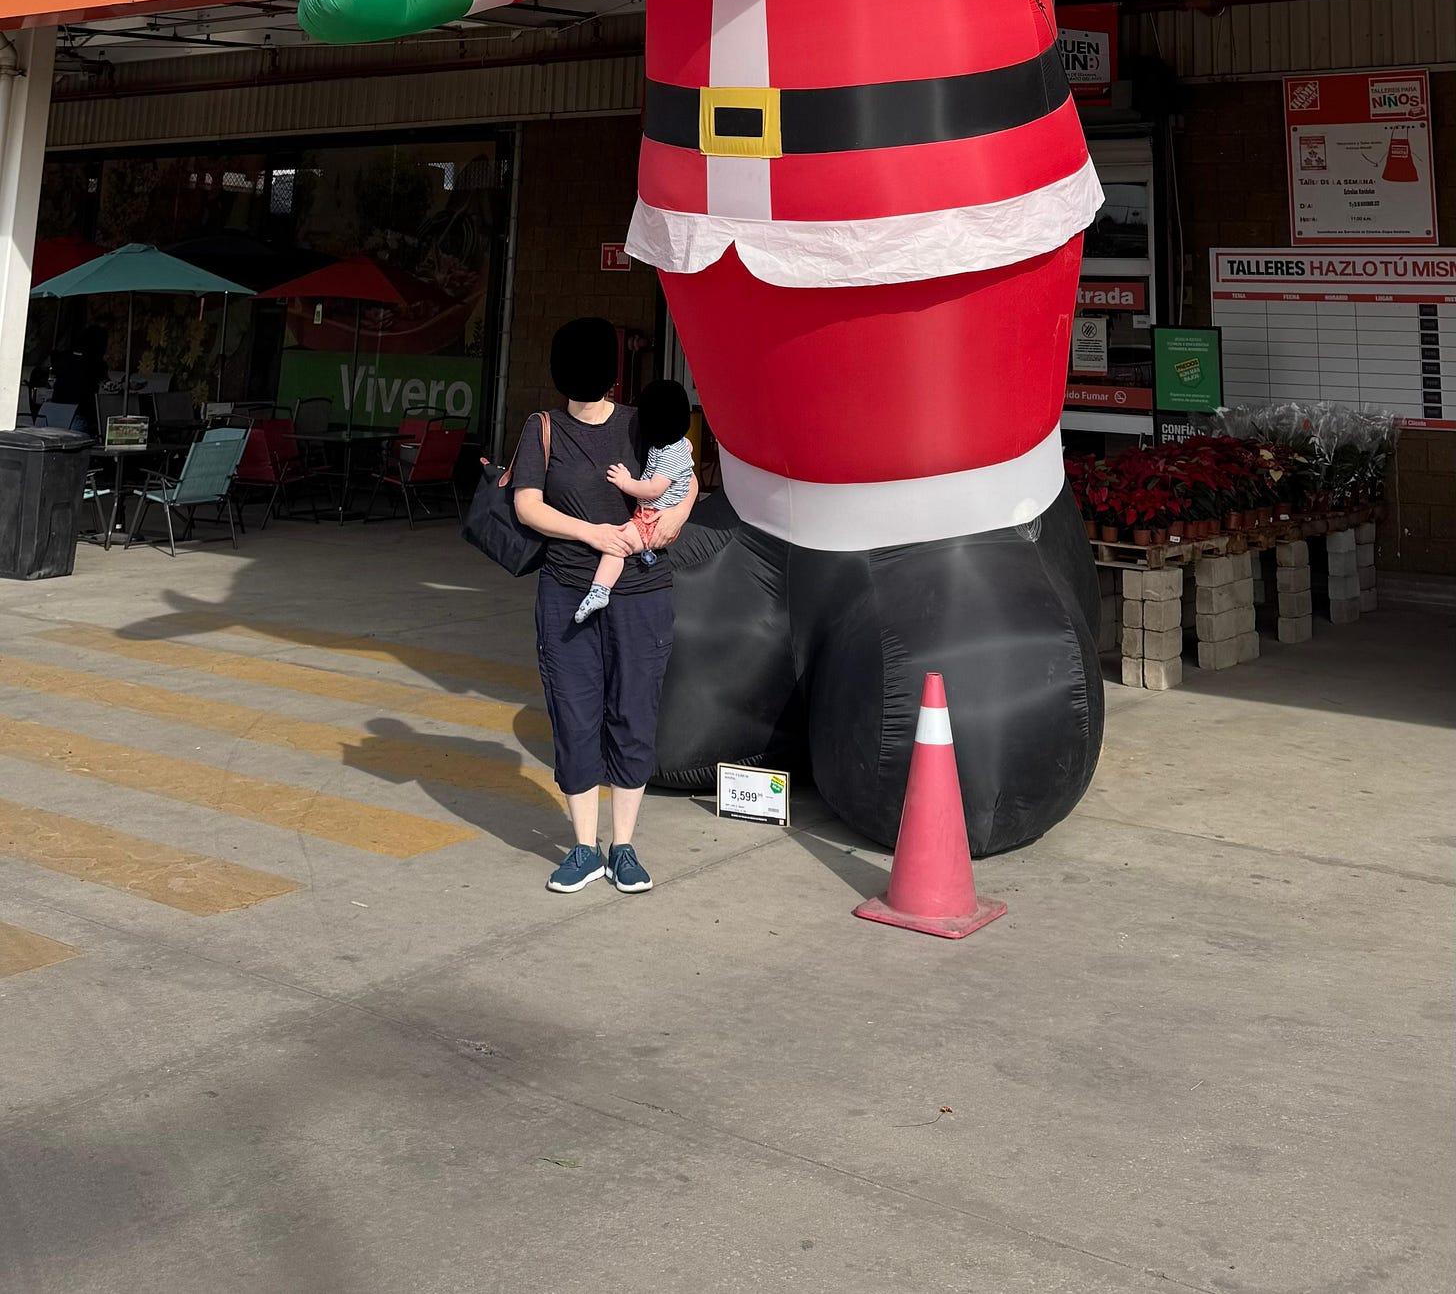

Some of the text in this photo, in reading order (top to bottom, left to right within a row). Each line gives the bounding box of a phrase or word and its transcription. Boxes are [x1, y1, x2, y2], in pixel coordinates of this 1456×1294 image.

[1372, 94, 1420, 108] NIÑOS
[1227, 260, 1306, 277] TALLERES
[1309, 260, 1378, 278] HAZLO
[1379, 256, 1408, 278] TÚ
[340, 364, 473, 417] Vivero
[1081, 391, 1109, 402] Fumar
